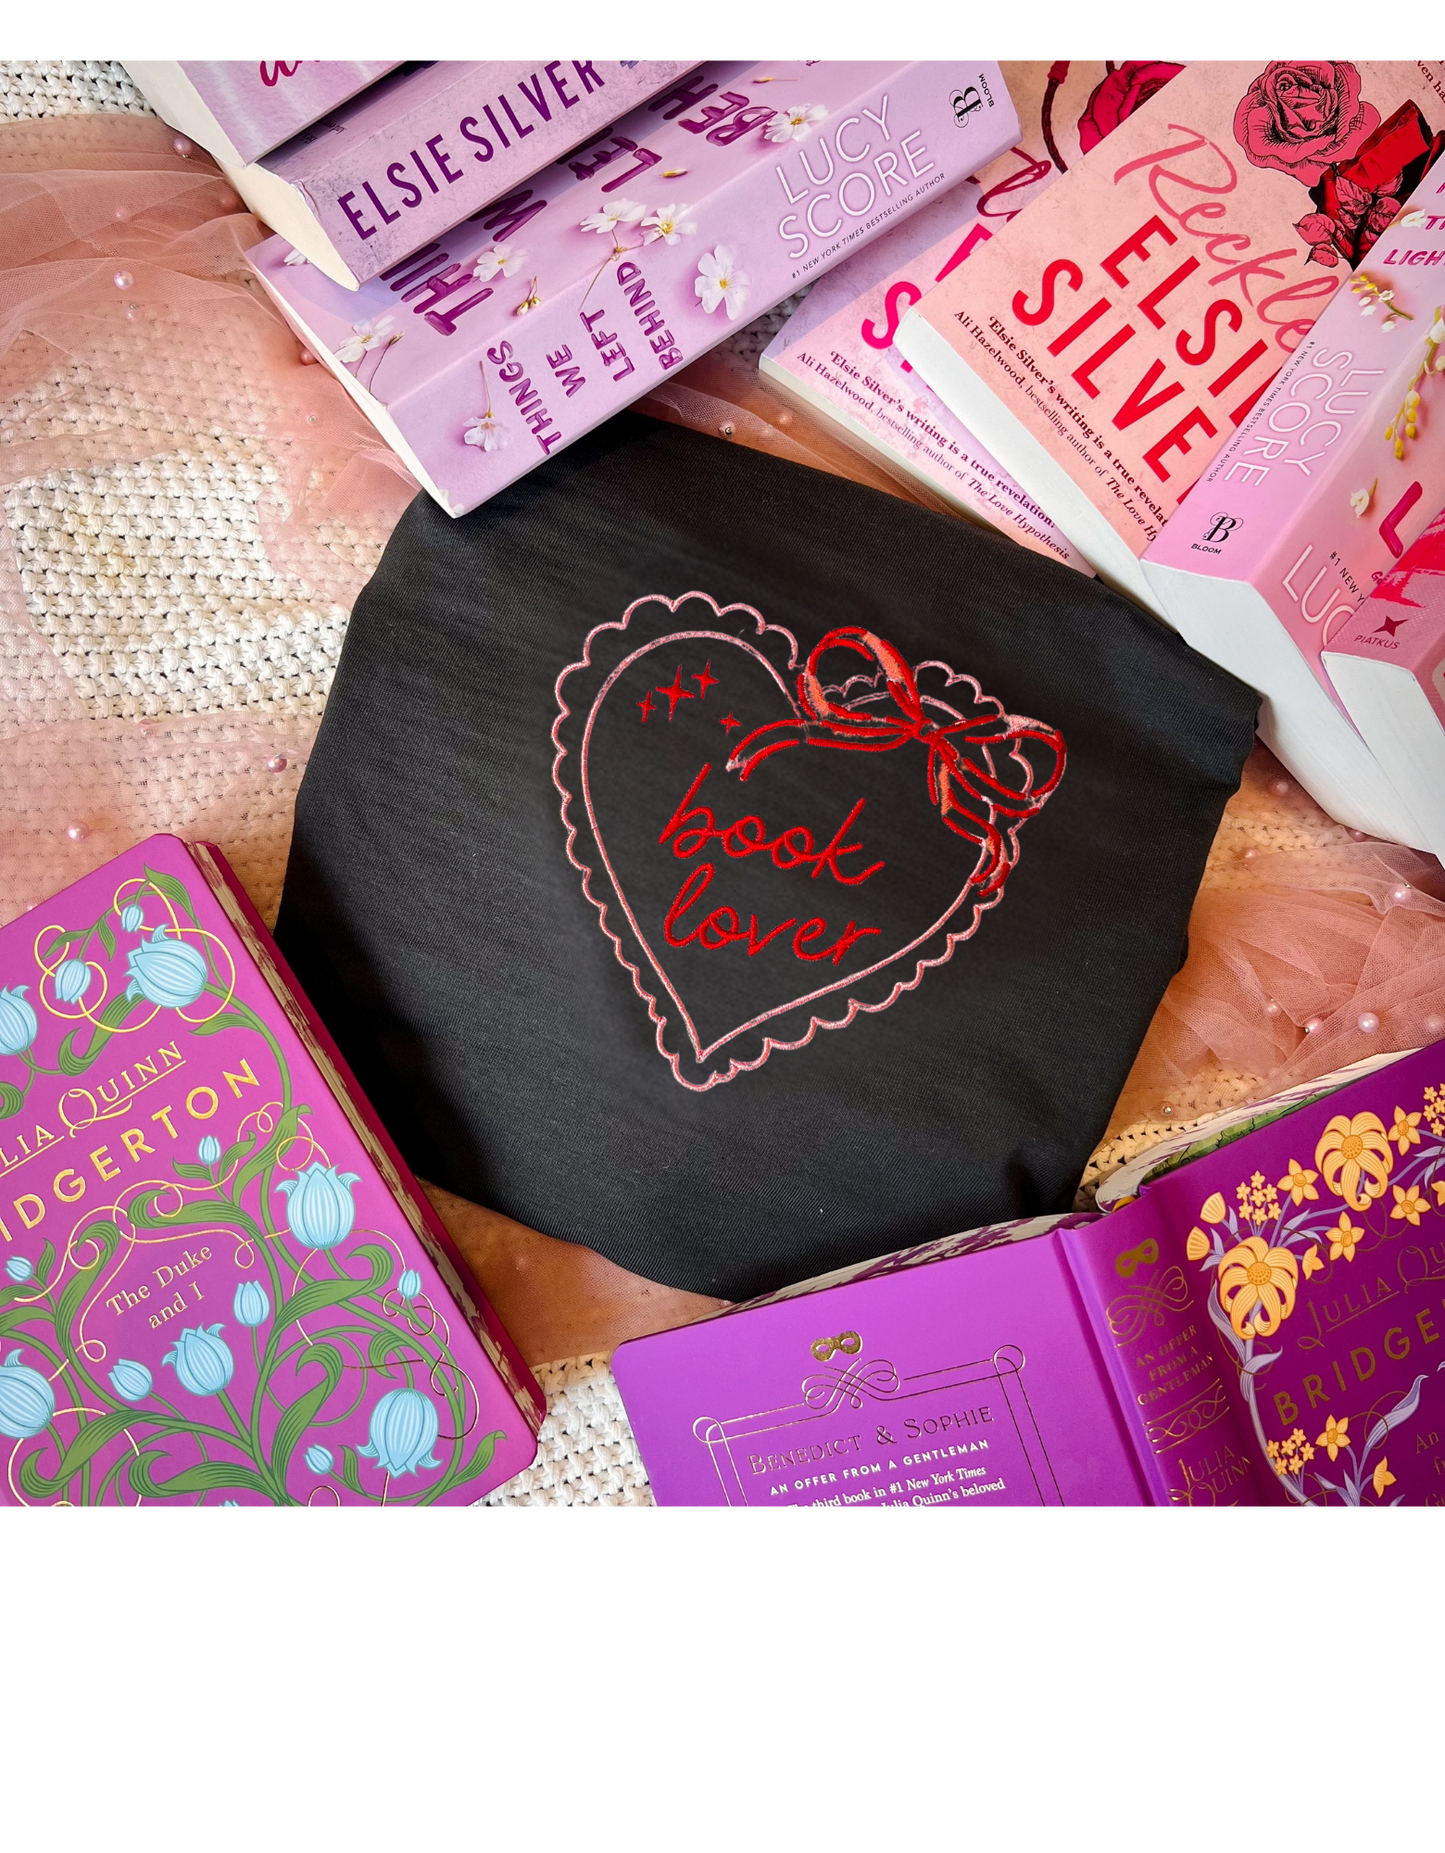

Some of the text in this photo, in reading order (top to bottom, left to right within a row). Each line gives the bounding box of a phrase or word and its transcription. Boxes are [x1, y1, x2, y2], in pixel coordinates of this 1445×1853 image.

[978, 73, 995, 107] BLOOM
[337, 58, 605, 240] ELSIE SILVER
[775, 94, 892, 206] LUCY
[778, 130, 936, 259] SCORE
[791, 172, 946, 279] #1 NEW YORK TIMES BESTSELLING AUTHOR
[1383, 249, 1445, 266] LIGH
[579, 309, 635, 381] LEFT
[616, 261, 684, 370] BEHIND
[486, 340, 562, 455] THINGS
[545, 344, 586, 398] WE
[1012, 258, 1218, 505] SILVE
[906, 409, 948, 448] writing
[948, 441, 960, 455] is
[960, 453, 969, 463] a
[970, 460, 995, 482] true
[954, 311, 1146, 525] Ali Hazelwood, bestselling author of The Love
[1055, 393, 1095, 440] writing
[1092, 435, 1105, 450] is
[1103, 449, 1113, 459] a
[1112, 458, 1135, 485] true
[1206, 341, 1315, 483] #1 NEW YORK TIMES BESTSELLING AUTHOR
[1223, 348, 1353, 487] SCORE
[1284, 367, 1385, 476] LUCY
[797, 352, 1070, 560] Ali Hazelwood, bestselling author of The Love Hypothesis
[1190, 543, 1222, 555] BLOOM
[1328, 551, 1360, 594] #1 NEW
[1354, 633, 1400, 650] PIATKUS
[659, 763, 885, 885] book
[664, 863, 881, 966] lover
[58, 1041, 184, 1138] QUINN
[106, 1244, 213, 1318] The Duke
[147, 1280, 206, 1329] and I
[1297, 1276, 1392, 1350] JULIA
[1136, 1324, 1198, 1368] AN OFFER
[1136, 1351, 1214, 1406] GENTLEMAN
[1148, 1345, 1199, 1382] FROM A
[1273, 1299, 1445, 1426] BRIDGE
[747, 1406, 995, 1475] BENEDICT & SOPHIE
[769, 1439, 990, 1496] AN OFFER FROM A GENTLEMAN
[1167, 1444, 1236, 1501] JULIA
[1415, 1431, 1440, 1455] An
[811, 1494, 841, 1509] third
[841, 1488, 872, 1504] book
[872, 1486, 887, 1498] in
[888, 1481, 904, 1494] #1
[905, 1477, 930, 1491] New
[929, 1471, 955, 1487] York
[955, 1465, 987, 1481] Times
[961, 1477, 1006, 1498] beloved
